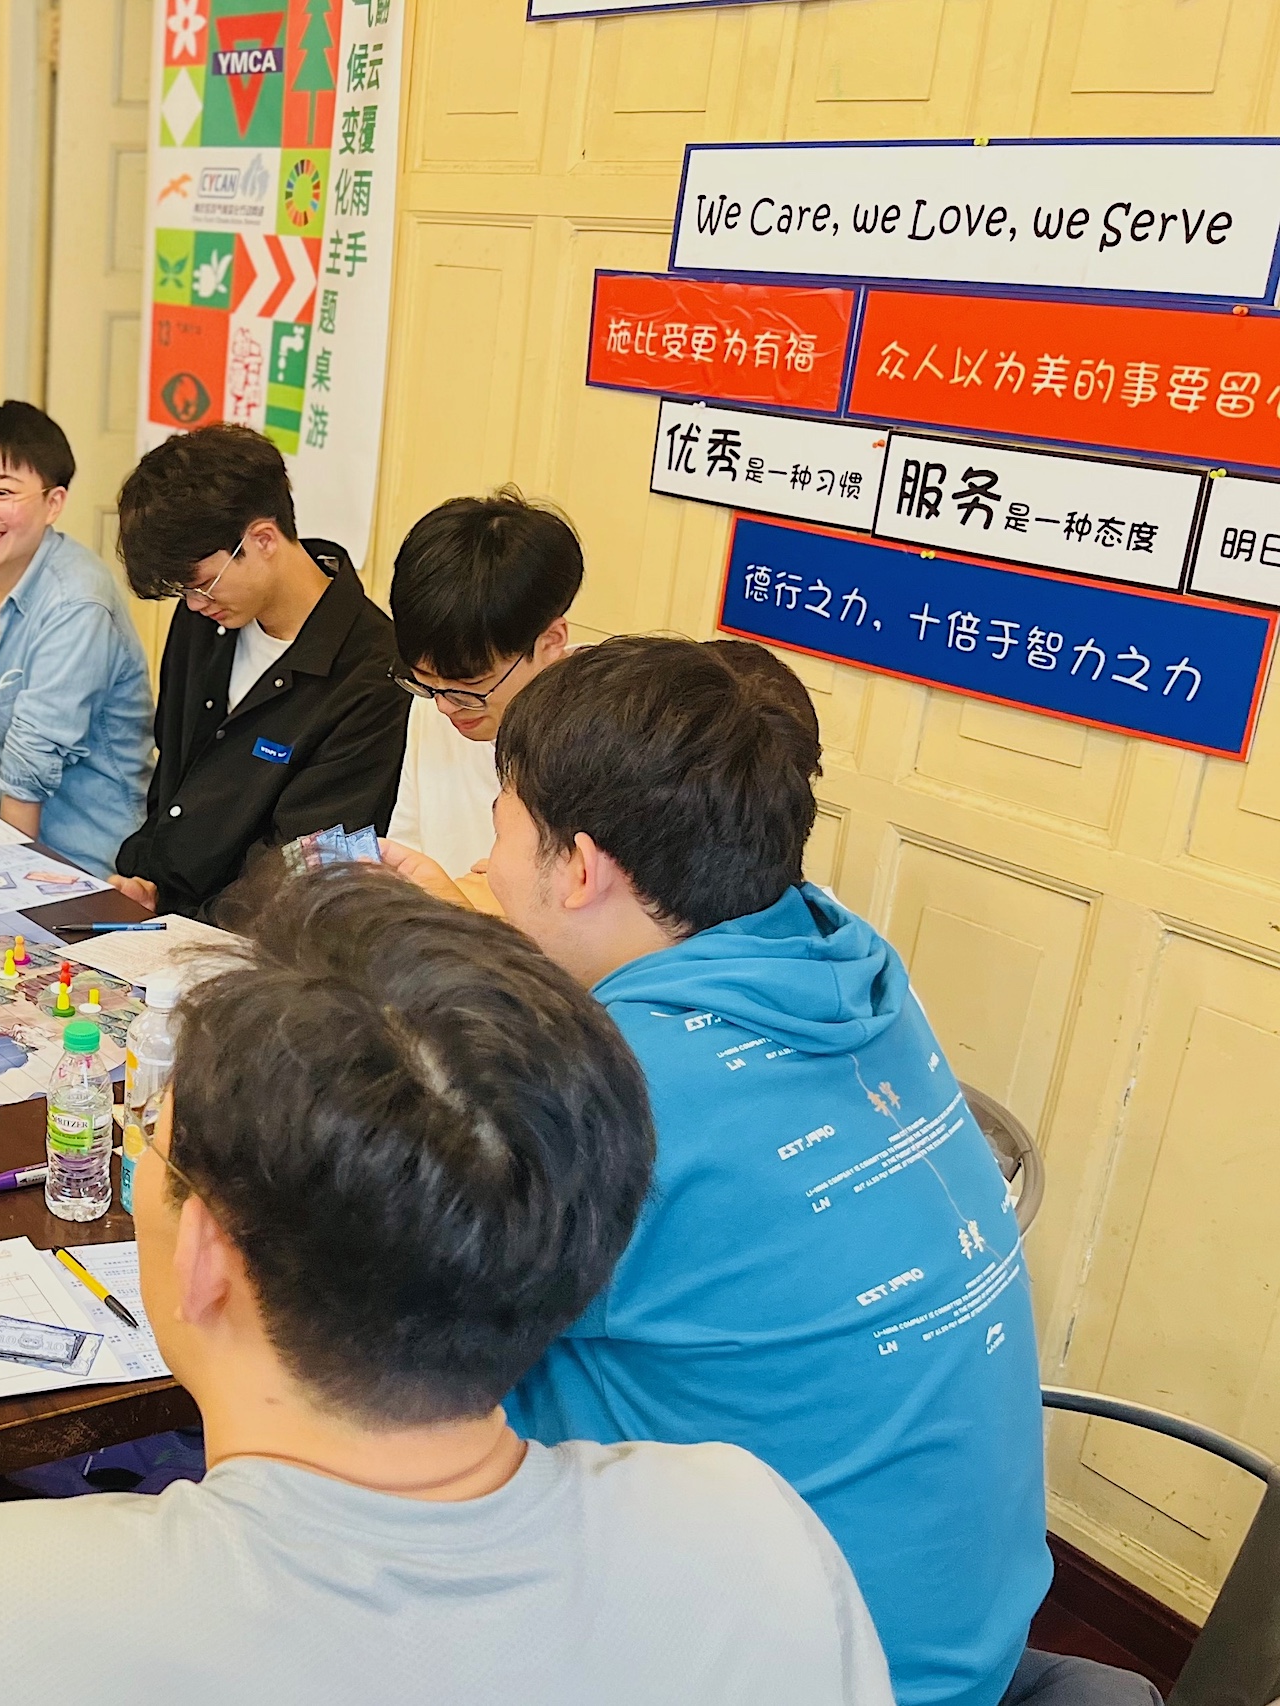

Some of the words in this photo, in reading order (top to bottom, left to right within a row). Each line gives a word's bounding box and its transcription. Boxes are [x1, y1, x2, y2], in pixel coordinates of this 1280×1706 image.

[217, 49, 277, 75] YMCA
[697, 194, 741, 236] We
[750, 197, 840, 237] Care,
[853, 203, 901, 234] we
[907, 199, 1017, 242] Love,
[1033, 206, 1090, 240] we
[1098, 202, 1233, 252] Serve
[606, 318, 818, 374] 施比受更为有福
[875, 340, 1280, 418] 众人以为美的事要留
[666, 423, 863, 501] 优秀是一种习惯
[895, 459, 1159, 554] 服务是一种态度
[811, 1196, 832, 1214] LN
[878, 1339, 899, 1356] LN
